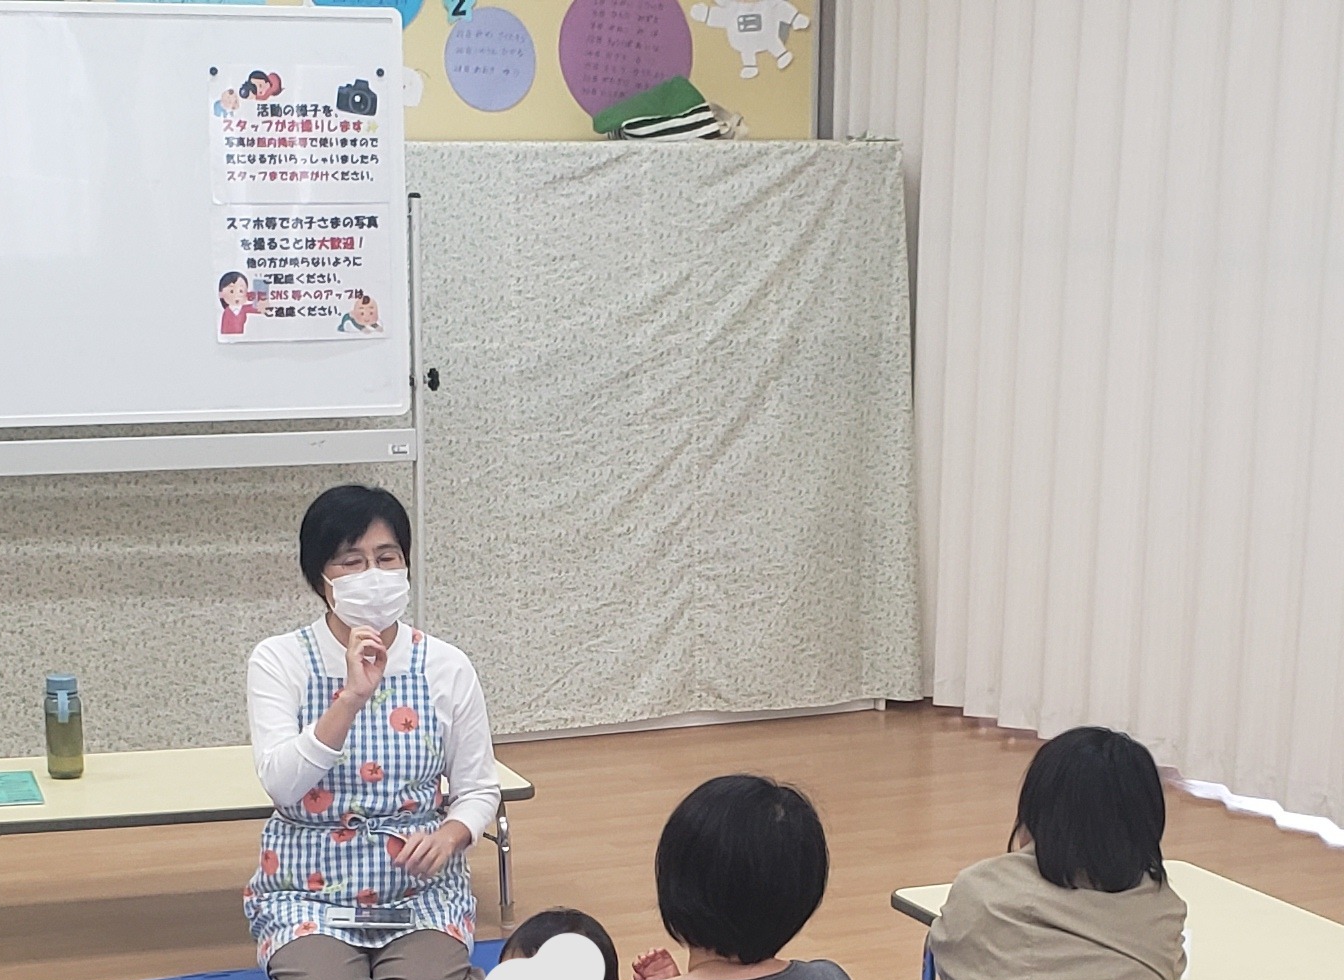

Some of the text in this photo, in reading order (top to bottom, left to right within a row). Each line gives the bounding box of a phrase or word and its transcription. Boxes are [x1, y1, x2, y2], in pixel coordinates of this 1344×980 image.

[226, 154, 379, 165] 気になる方いらっしゃいましたら
[226, 215, 378, 230] スマホ等でお子さまの写真
[246, 256, 362, 268] 他の方が映らないように
[263, 273, 341, 285] ご配慮ください。
[264, 305, 342, 318] ご遠慮ください。
